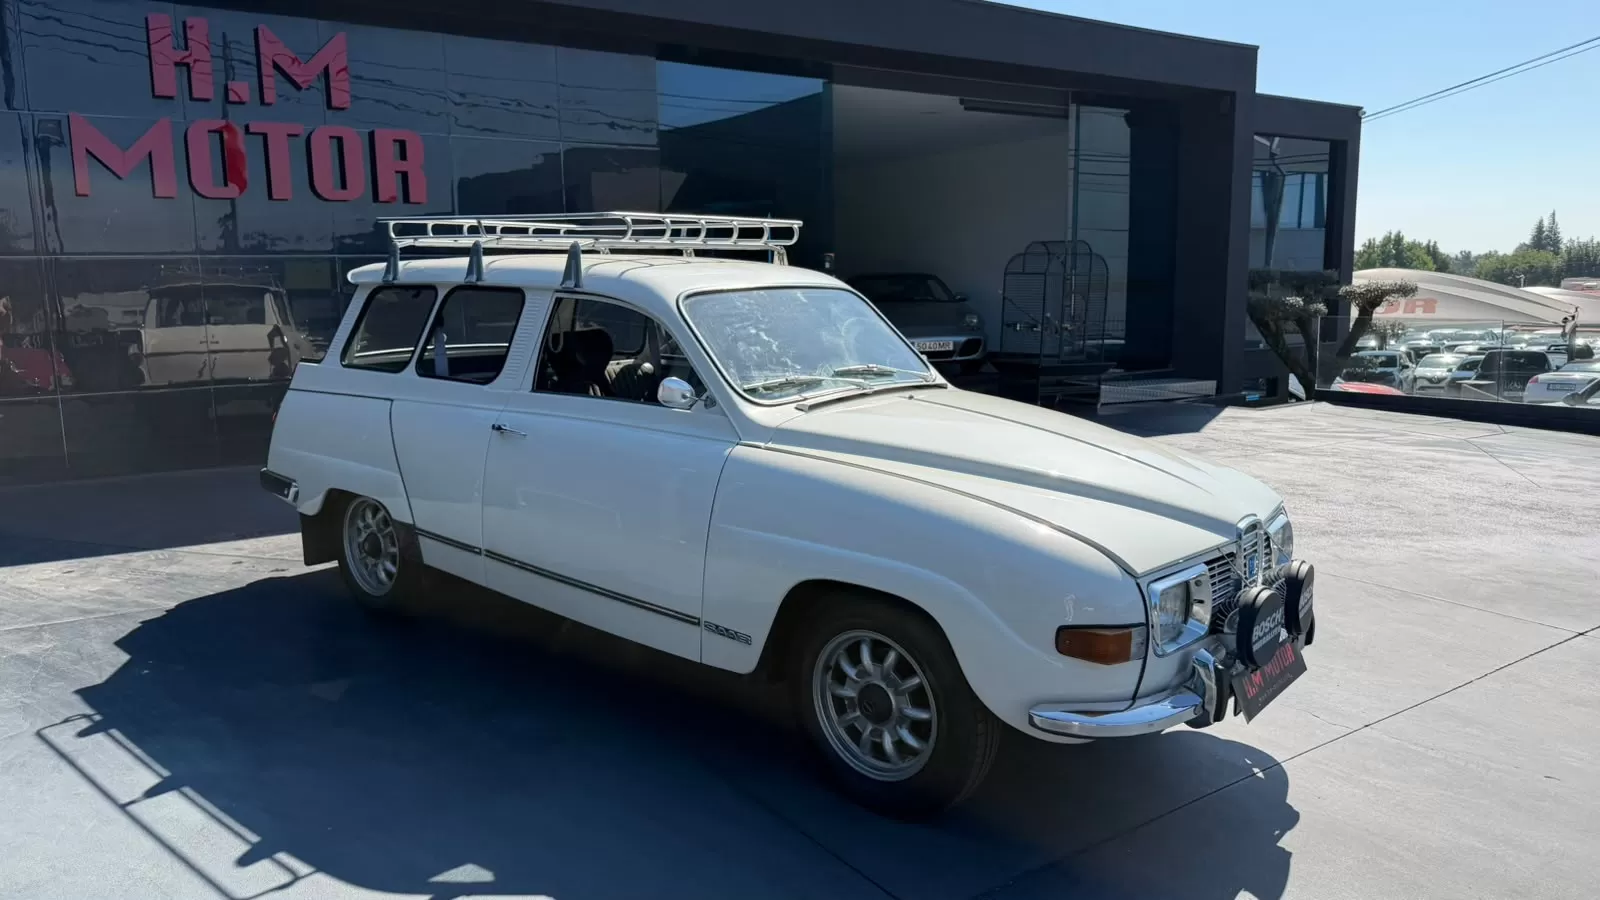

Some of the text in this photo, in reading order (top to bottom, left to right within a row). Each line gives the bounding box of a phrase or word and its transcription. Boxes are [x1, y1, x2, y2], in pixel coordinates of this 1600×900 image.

[146, 12, 350, 109] H.M
[68, 112, 428, 204] MOTOR
[1252, 608, 1282, 642] BOSCH
[1264, 642, 1296, 681] MOTOR
